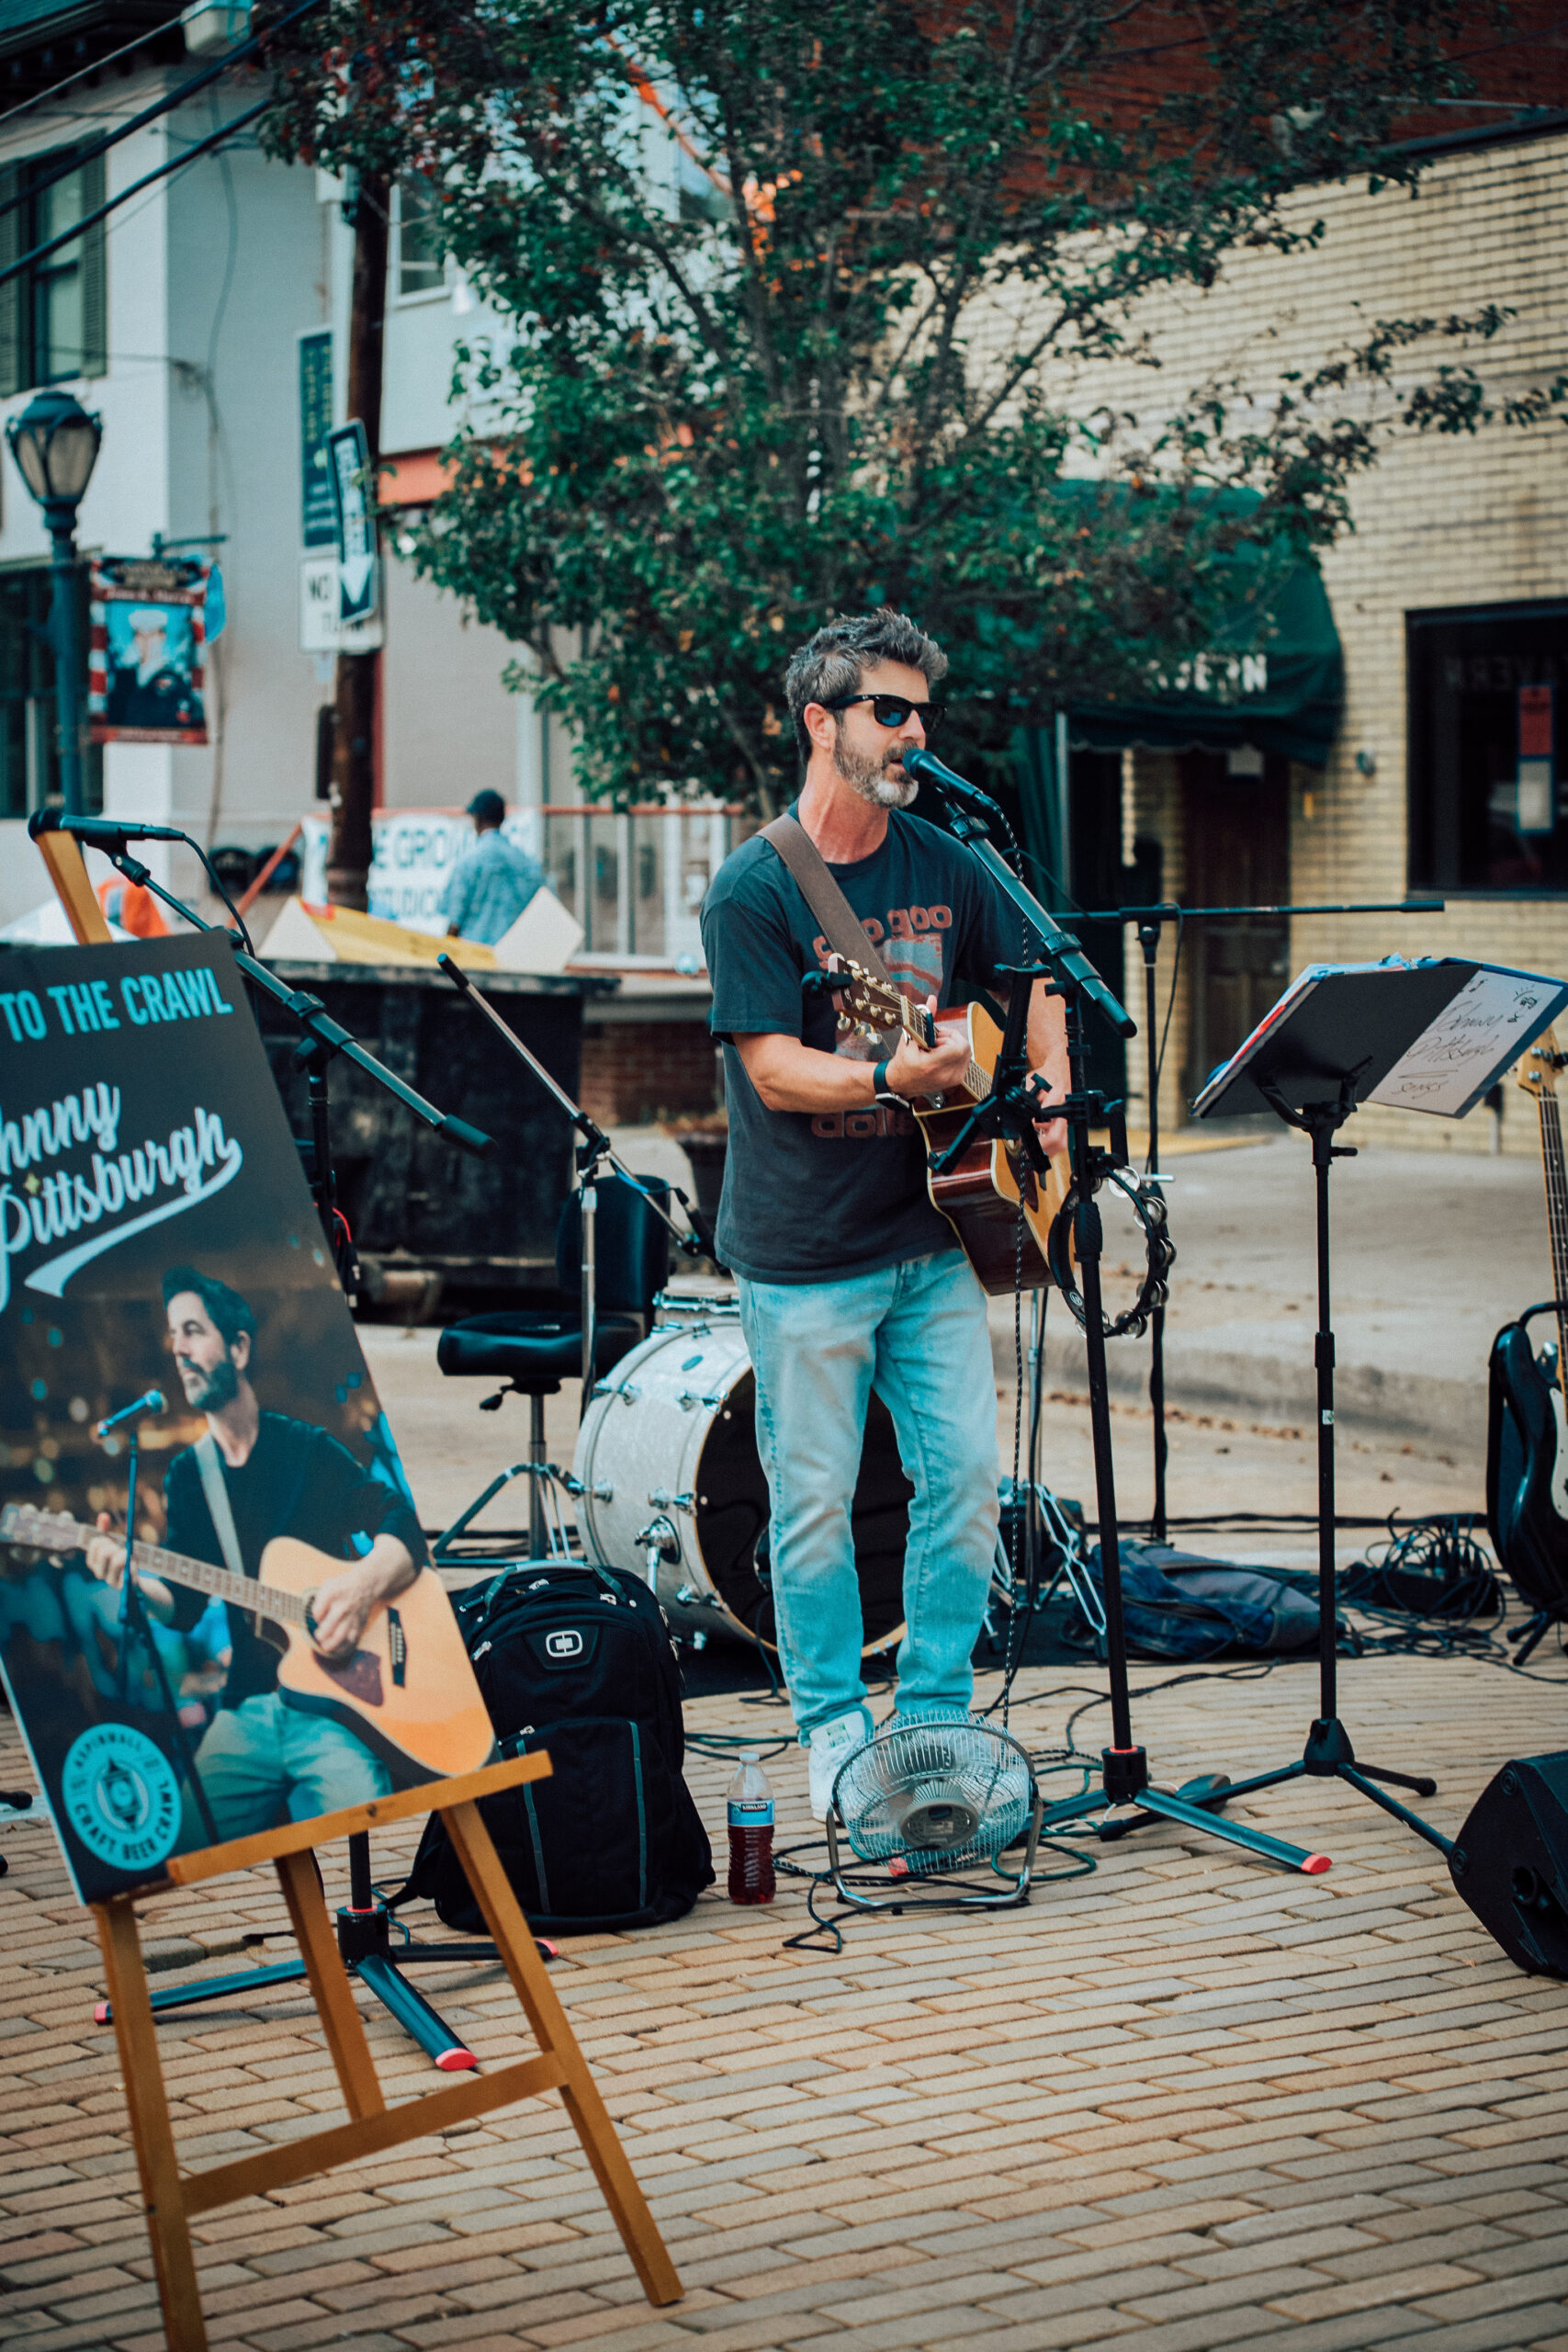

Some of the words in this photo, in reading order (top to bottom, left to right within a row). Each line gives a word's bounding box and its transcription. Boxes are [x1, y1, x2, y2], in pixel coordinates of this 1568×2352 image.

[887, 905, 952, 941] goo
[0, 990, 47, 1042] TO
[47, 979, 120, 1035] THE
[120, 967, 232, 1026] CRAWL
[74, 1803, 117, 1854] CRAFT
[122, 1838, 157, 1860] BEER
[155, 1781, 173, 1840] CRAWL
